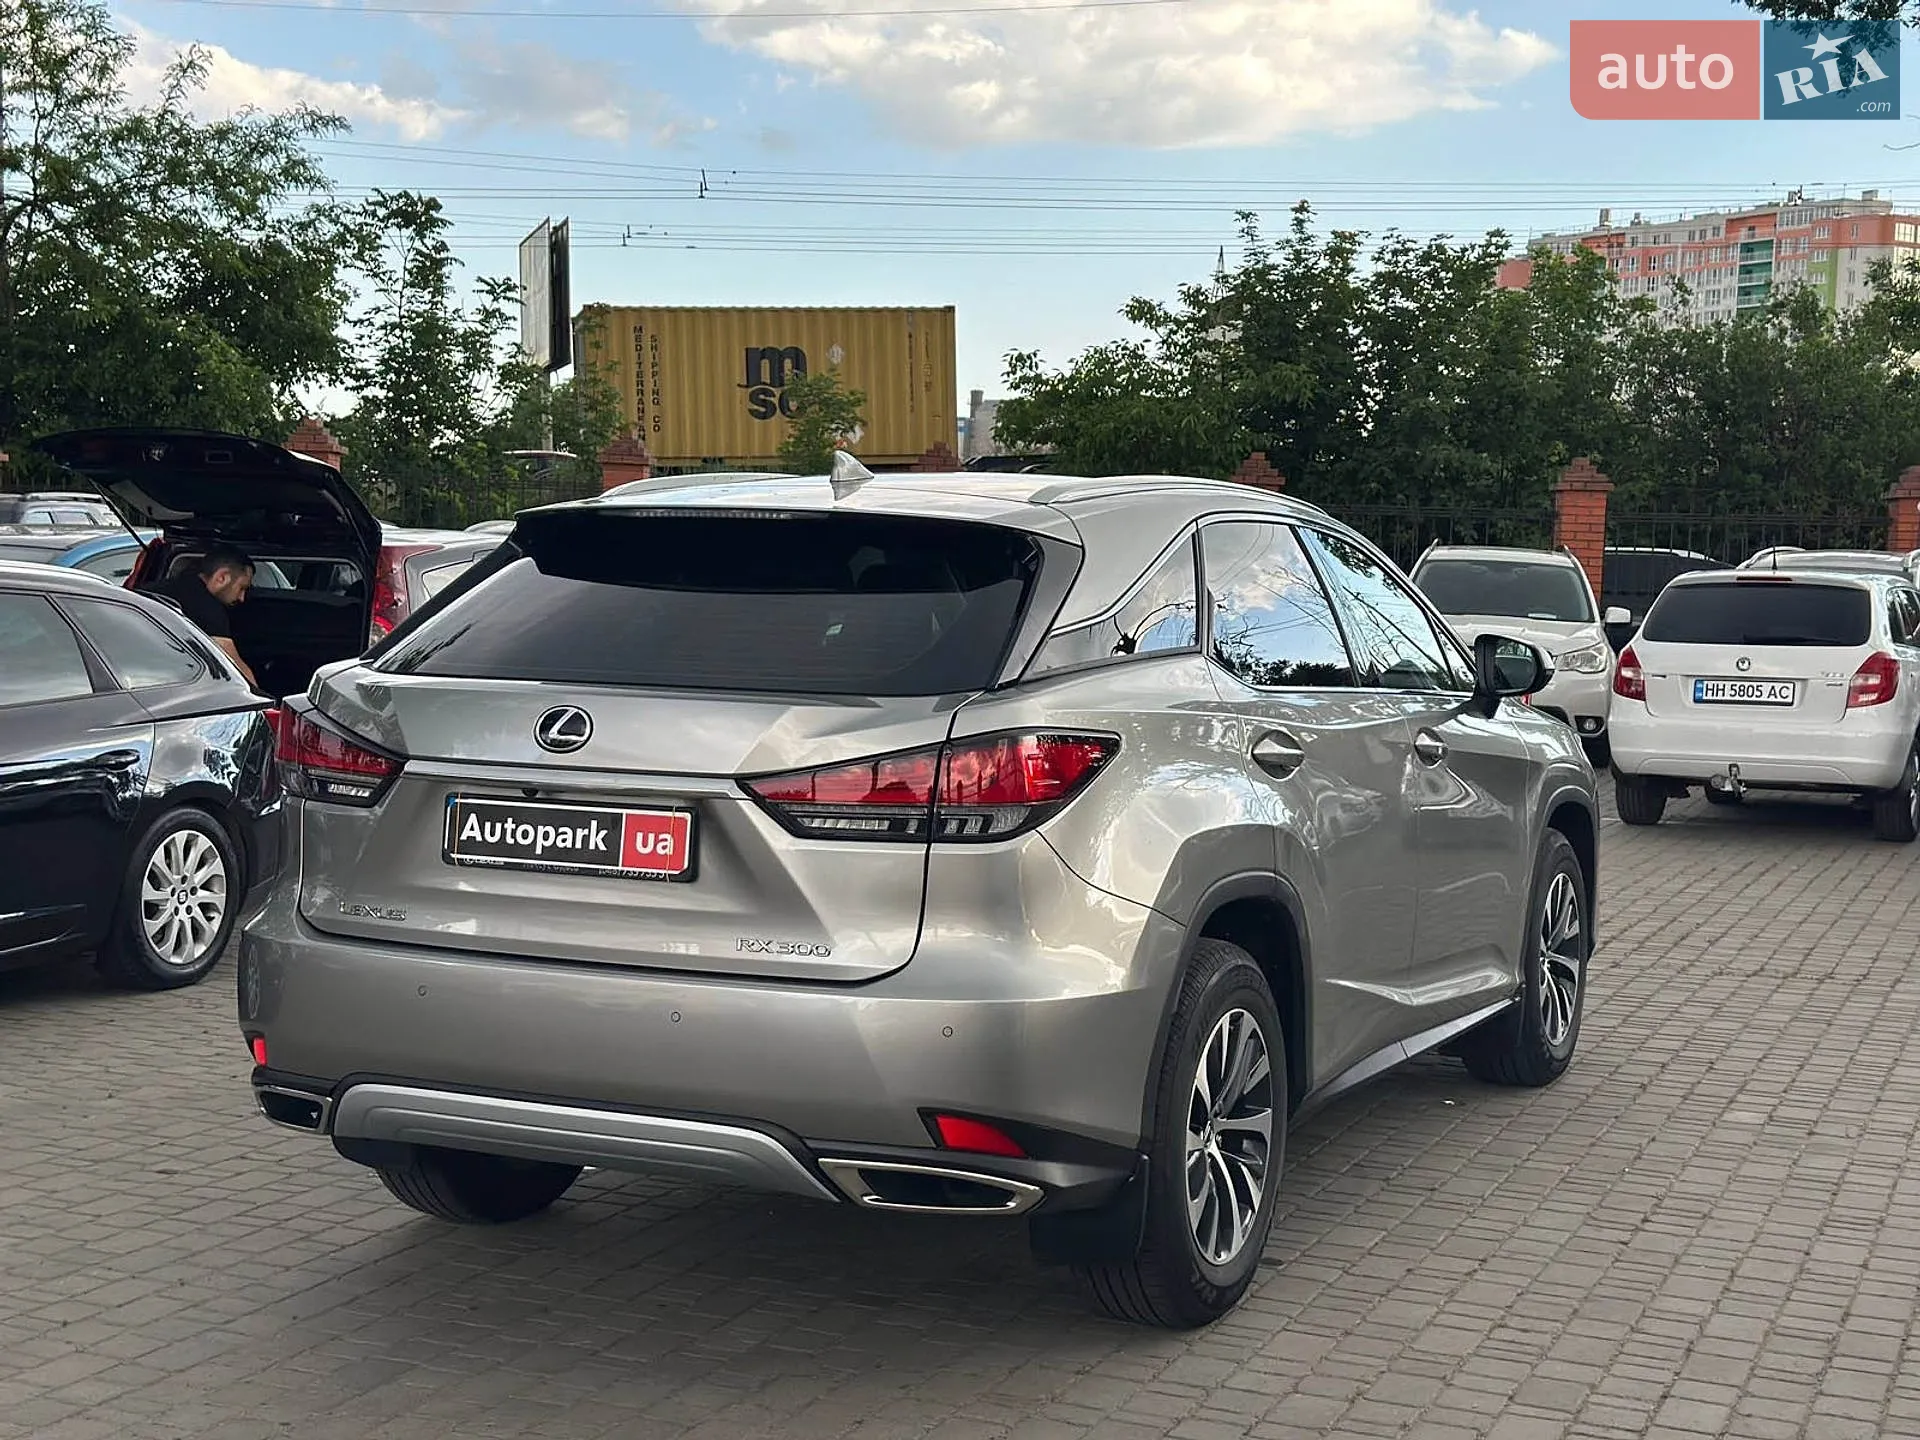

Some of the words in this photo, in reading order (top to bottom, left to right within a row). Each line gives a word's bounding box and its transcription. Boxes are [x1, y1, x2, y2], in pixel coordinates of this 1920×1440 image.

[650, 333, 660, 406] SHIPPING
[652, 414, 661, 433] CO
[1704, 683, 1727, 697] HH
[1729, 684, 1763, 699] 5805
[1766, 685, 1790, 700] AC
[459, 812, 608, 855] Autopark
[635, 830, 675, 856] ua
[339, 901, 406, 922] LEXUS
